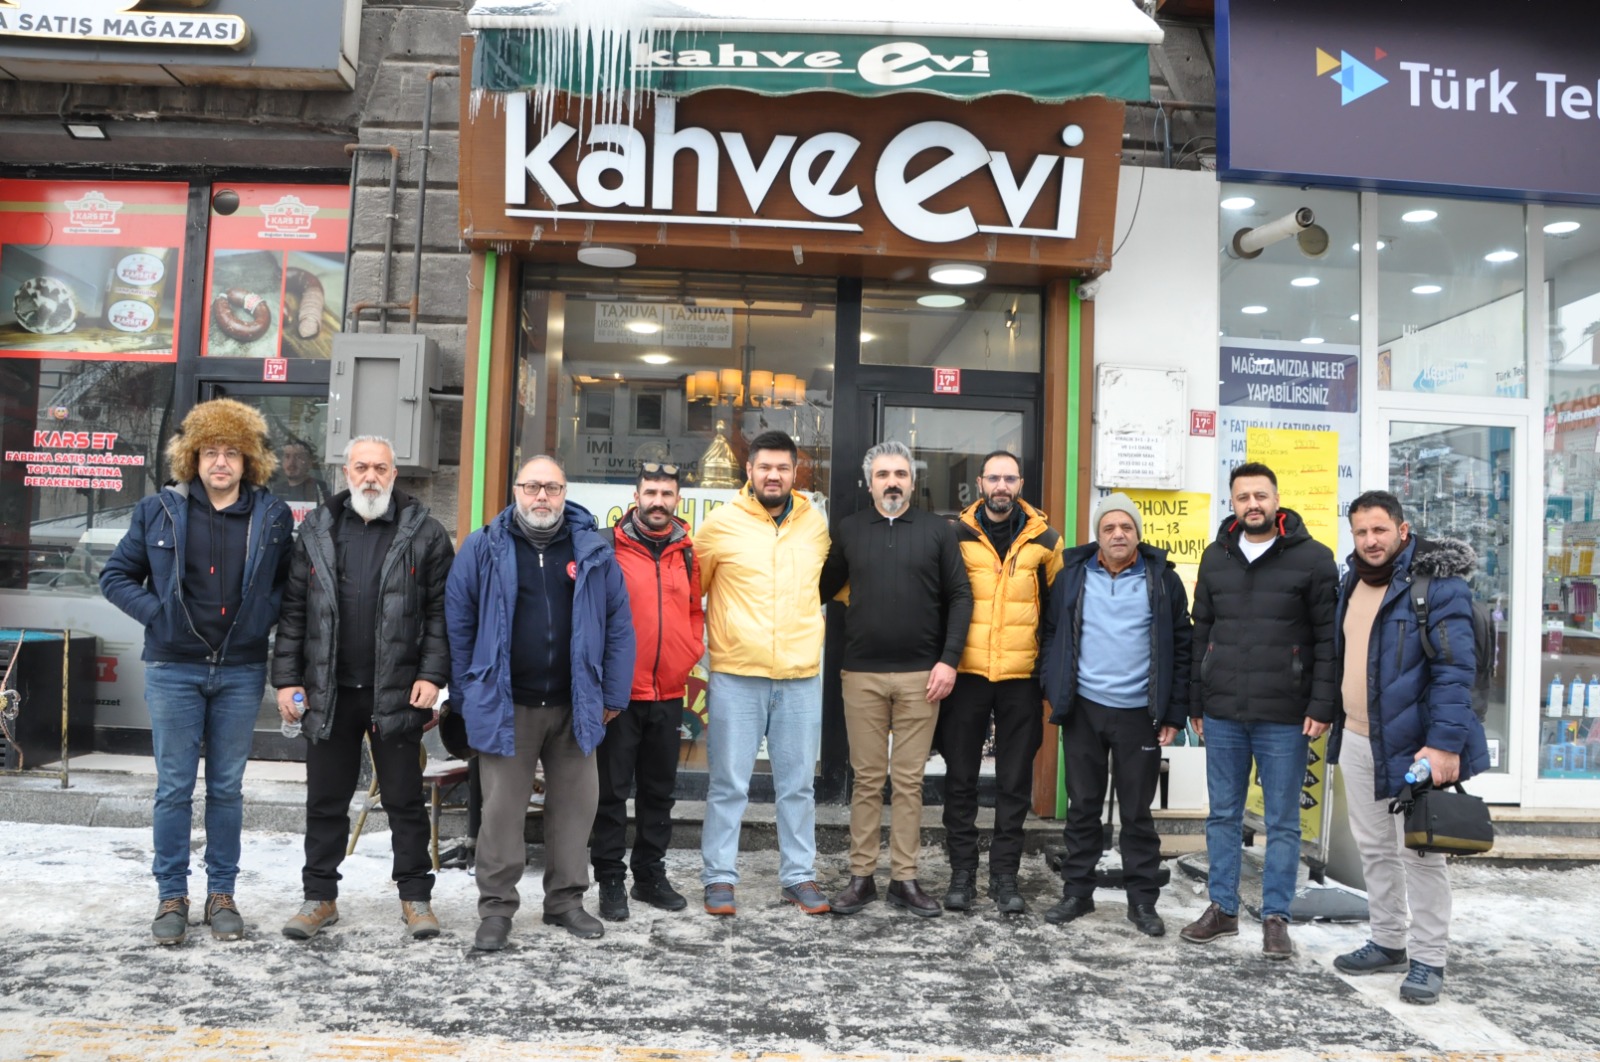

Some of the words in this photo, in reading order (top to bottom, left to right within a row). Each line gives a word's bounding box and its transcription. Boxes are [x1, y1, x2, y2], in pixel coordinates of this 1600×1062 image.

[19, 14, 92, 36] SATIŞ
[103, 16, 237, 39] MAĞAZASI
[636, 43, 843, 68] kahve
[857, 42, 990, 86] evi
[1400, 61, 1518, 115] Türk
[505, 92, 863, 218] kahve
[875, 120, 1084, 243] evi
[1231, 353, 1309, 378] MAĞAZAMIZDA
[1311, 361, 1345, 380] NELER
[1247, 382, 1329, 405] YAPABİLİRSİNİZ
[6, 451, 53, 462] FABRİKA
[55, 453, 85, 465] SATIŞ
[87, 452, 145, 465] MAĞAZASI
[27, 464, 70, 475] TOPTAN
[25, 477, 89, 488] PERAKENDE
[91, 479, 122, 491] SATIŞ
[1131, 499, 1189, 516] PHONE
